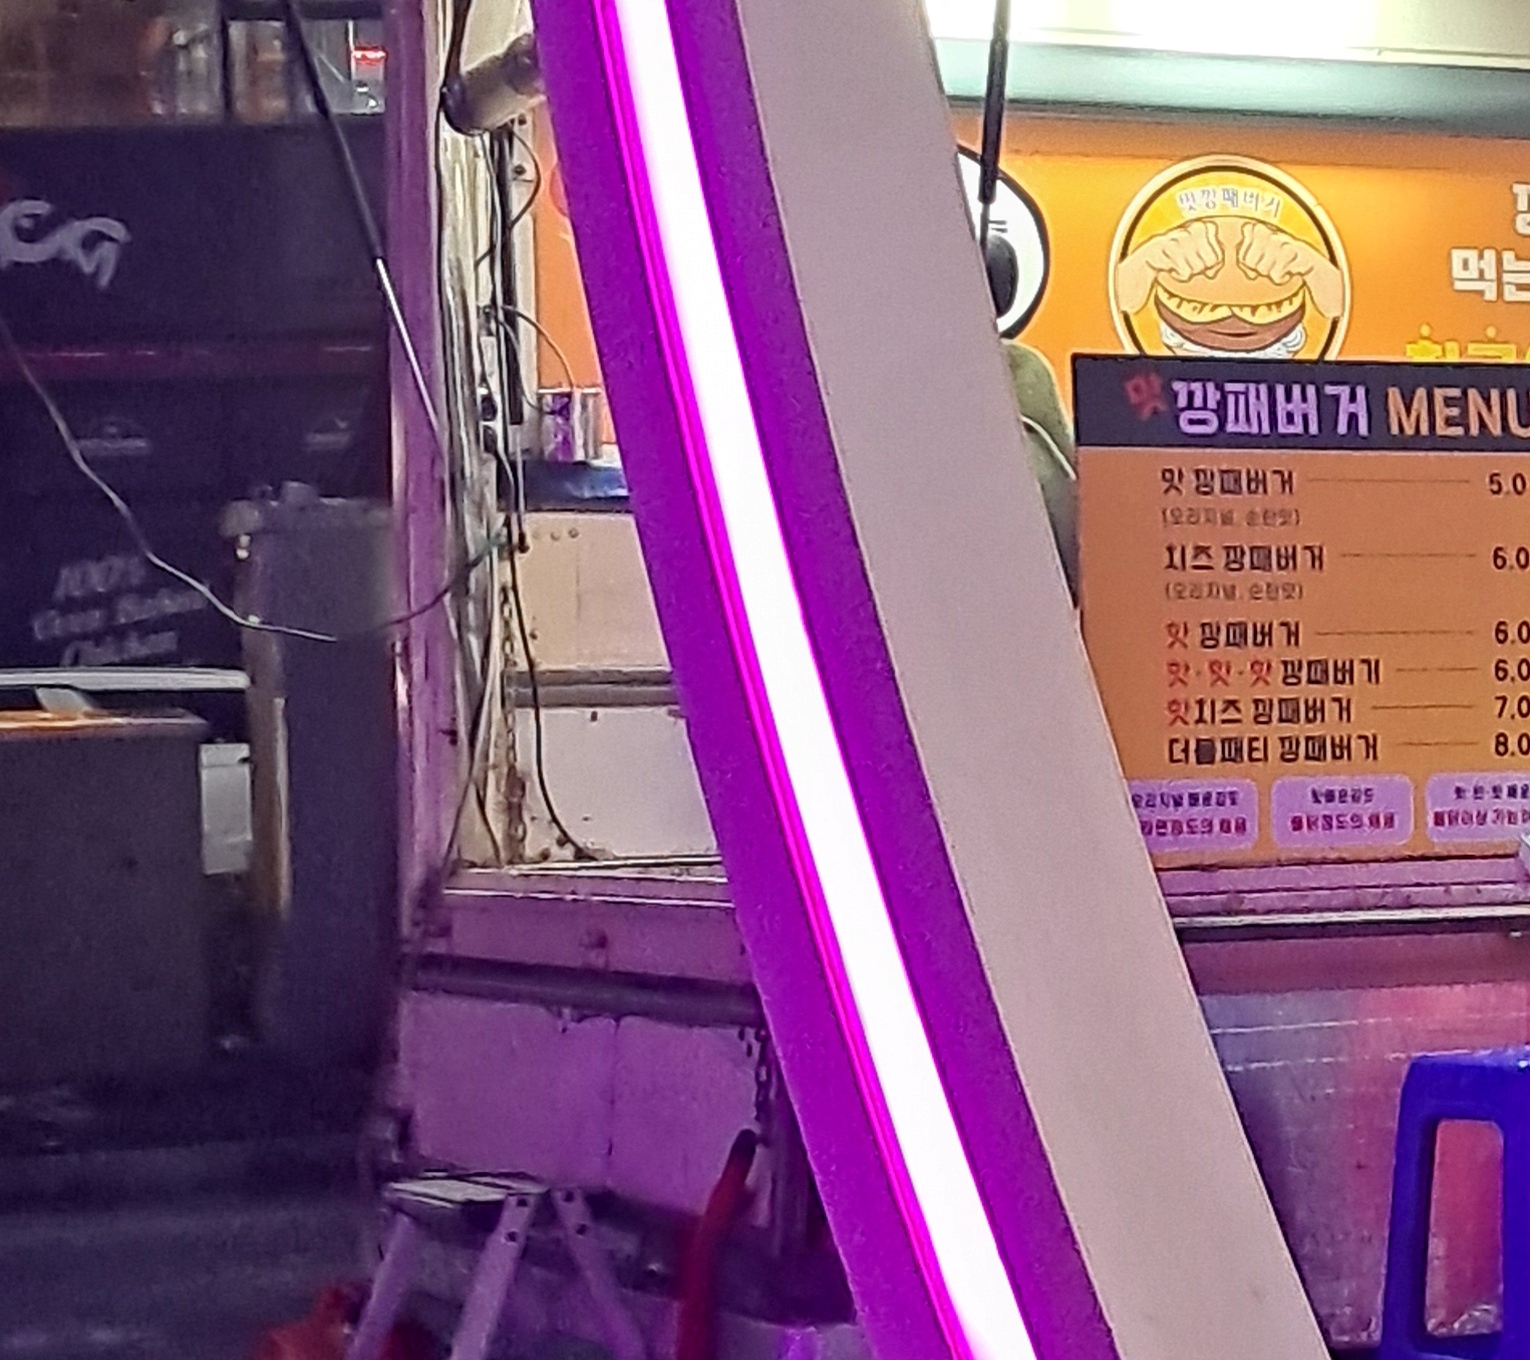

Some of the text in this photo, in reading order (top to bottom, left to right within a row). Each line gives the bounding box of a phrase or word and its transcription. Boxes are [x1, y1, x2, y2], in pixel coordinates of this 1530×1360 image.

[1171, 378, 1371, 438] 깡패버거
[1193, 468, 1295, 497] 깡패버거
[1488, 472, 1527, 496] 5.0
[1164, 543, 1530, 573] 치즈 깡패버거 6.0
[1199, 620, 1301, 649] 깡패버거
[1280, 658, 1380, 687] 깡패버거
[1251, 696, 1352, 725] 깡패버거
[1278, 733, 1379, 763] 깡패버거
